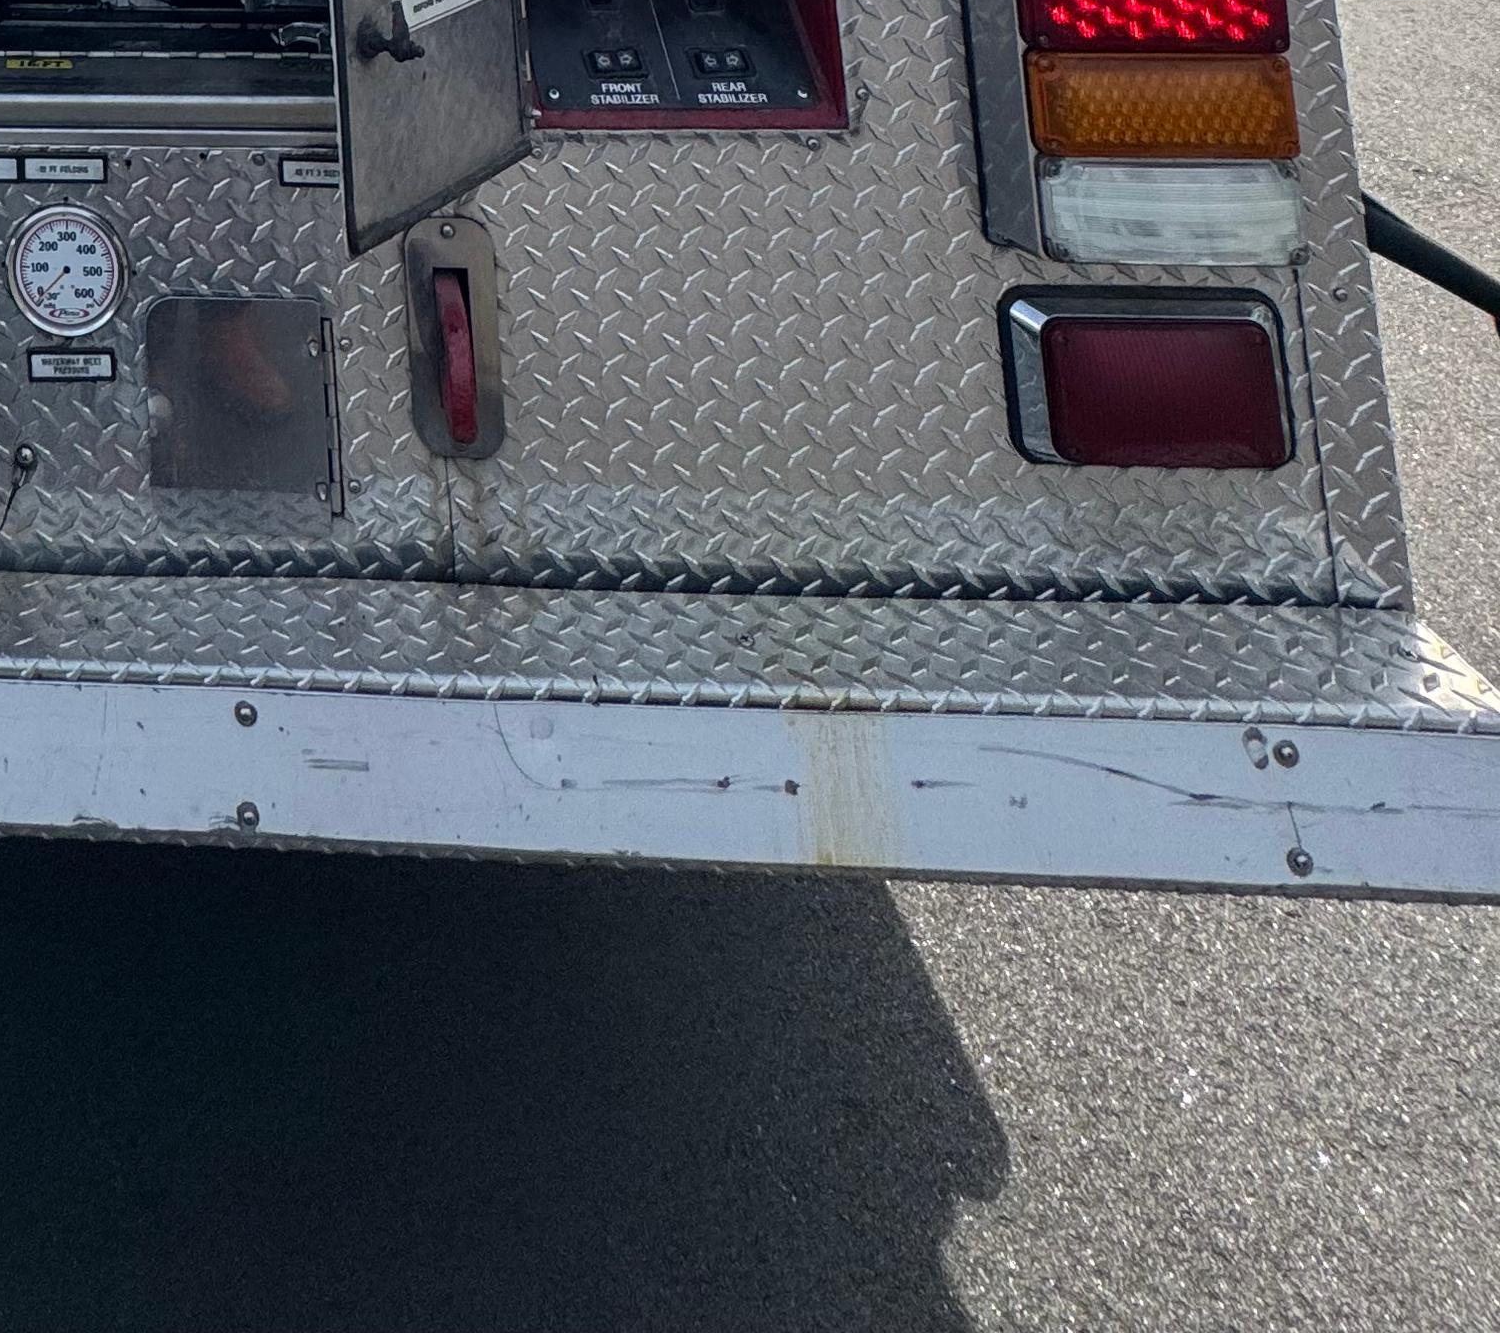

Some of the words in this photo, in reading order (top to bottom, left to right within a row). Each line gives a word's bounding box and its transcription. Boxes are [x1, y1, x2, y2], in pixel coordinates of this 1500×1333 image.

[601, 83, 642, 93] FRONT
[712, 82, 747, 92] REAR
[590, 94, 660, 105] STABILIZER
[698, 93, 768, 104] STABILIZER
[57, 231, 76, 241] 300
[39, 241, 58, 251] 200
[76, 244, 96, 255] 400
[31, 262, 49, 272] 100
[83, 266, 102, 276] 500
[37, 286, 44, 296] 0
[74, 288, 94, 298] 600
